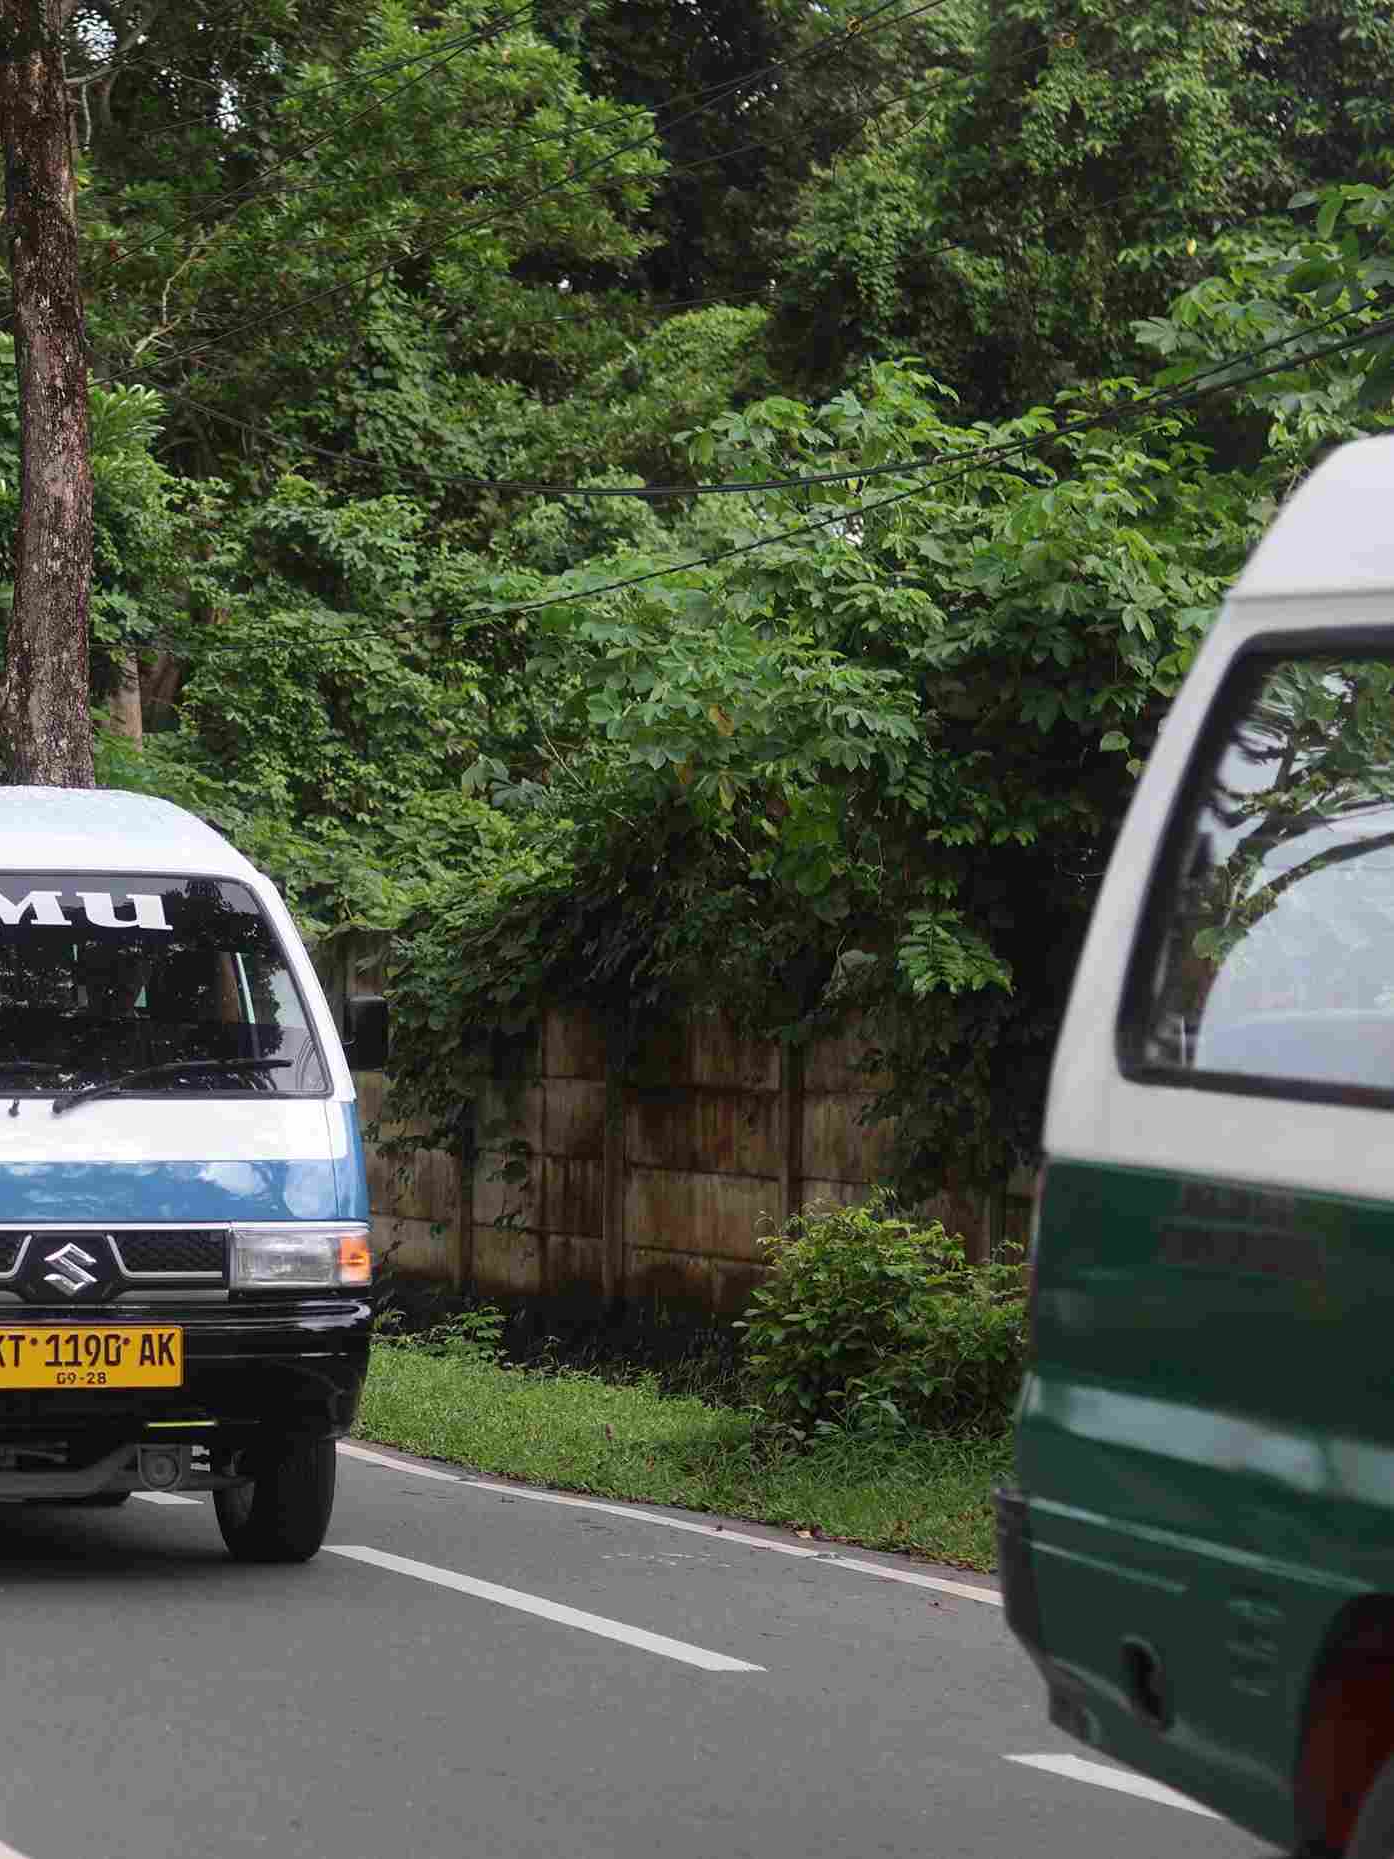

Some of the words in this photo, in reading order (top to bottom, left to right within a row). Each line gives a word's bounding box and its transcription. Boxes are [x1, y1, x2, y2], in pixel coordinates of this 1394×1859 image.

[44, 1333, 122, 1367] 1190
[139, 1332, 176, 1366] AK
[56, 1371, 107, 1385] 09-28
